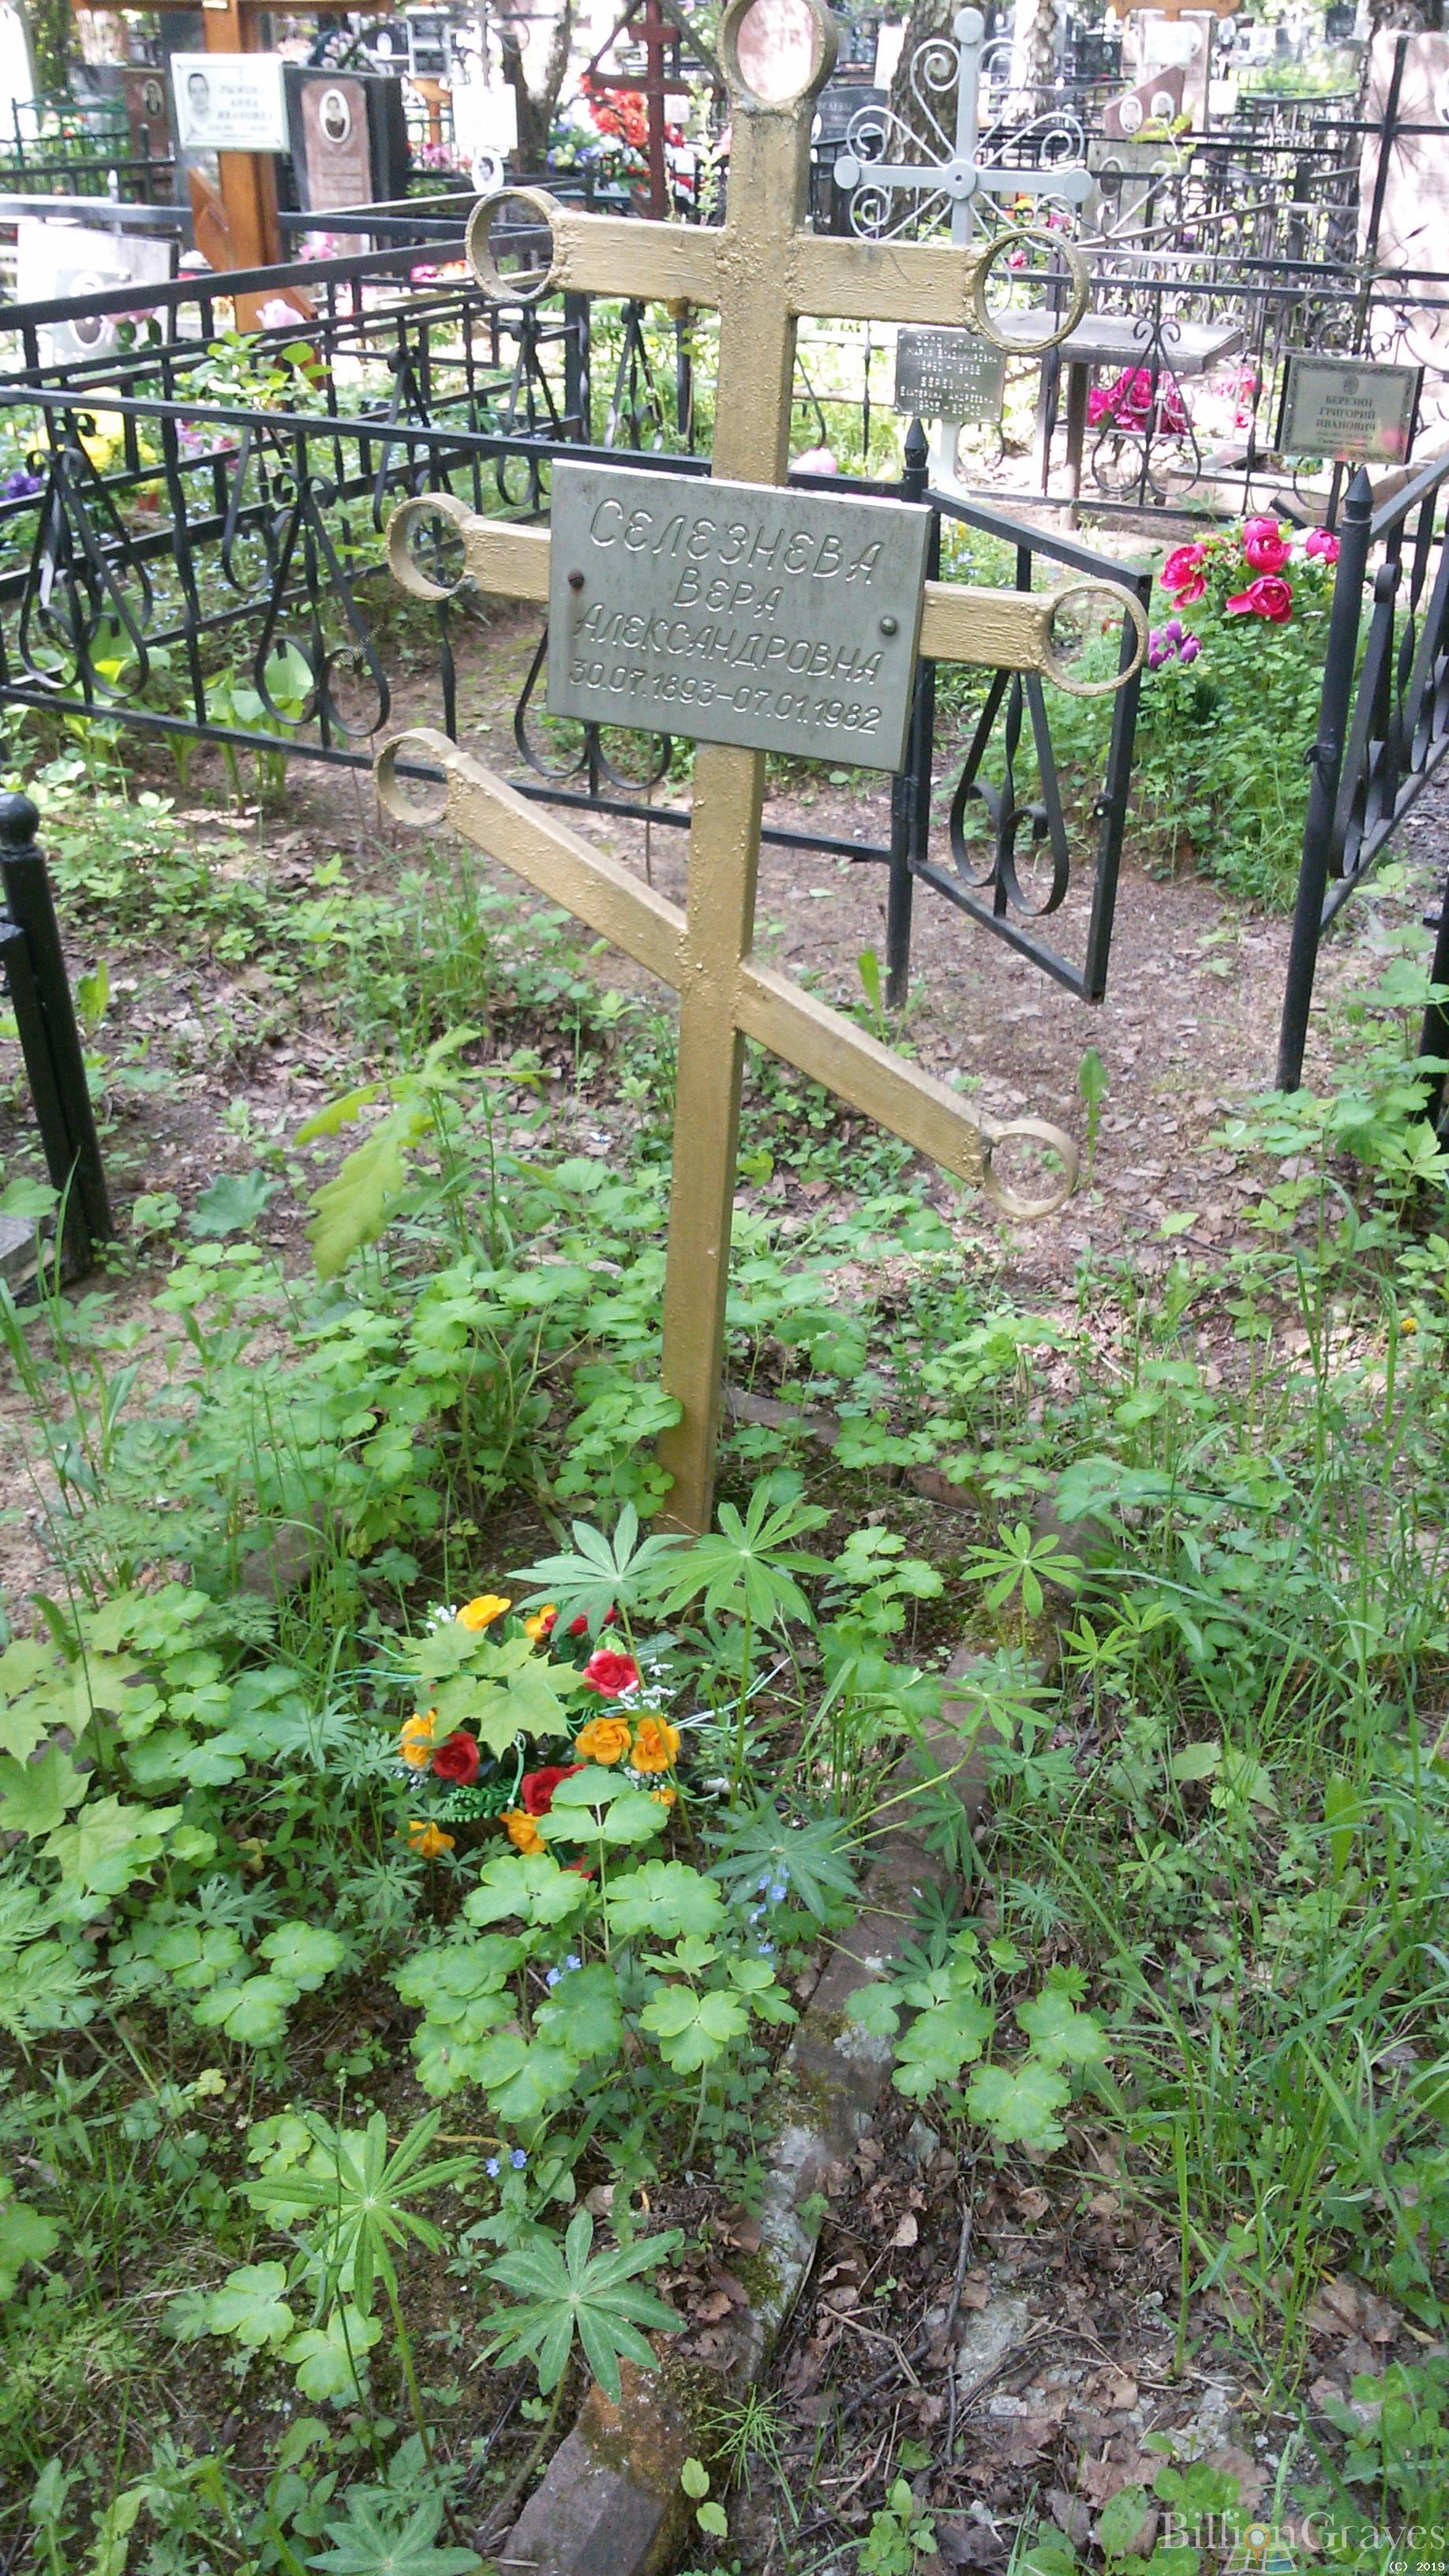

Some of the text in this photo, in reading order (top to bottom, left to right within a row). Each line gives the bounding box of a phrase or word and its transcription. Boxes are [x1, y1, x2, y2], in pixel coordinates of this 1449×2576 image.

[590, 497, 886, 586] СЕЛЕЗНЕВА
[673, 565, 784, 622] ВЕРА
[576, 602, 886, 685] АЛЕКСАНДРОВНА
